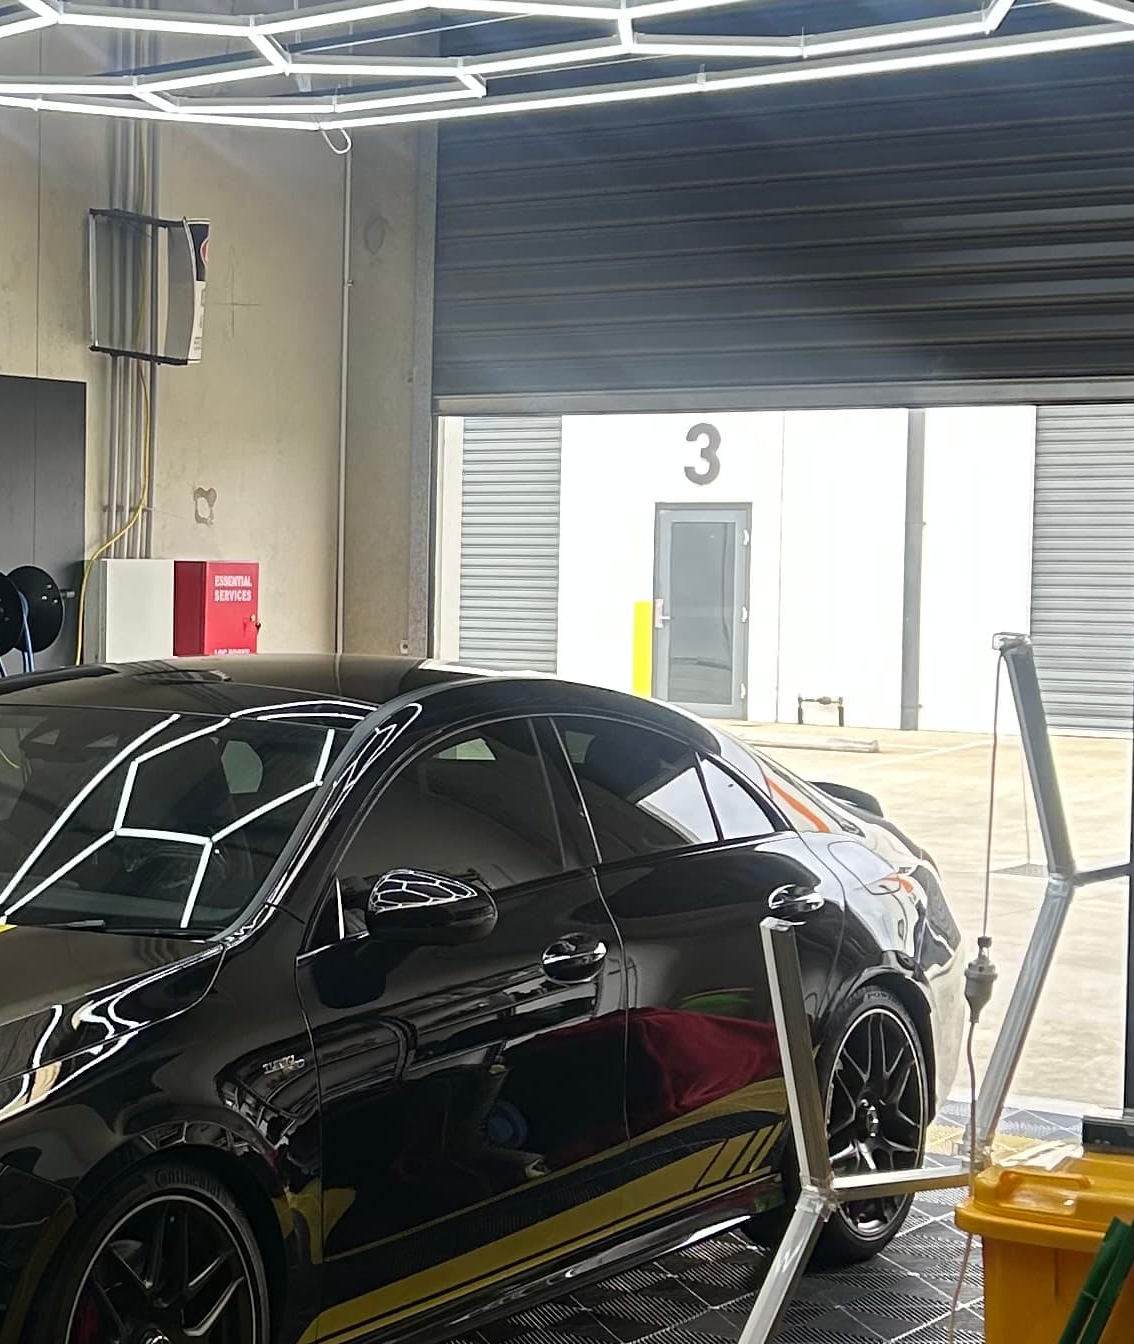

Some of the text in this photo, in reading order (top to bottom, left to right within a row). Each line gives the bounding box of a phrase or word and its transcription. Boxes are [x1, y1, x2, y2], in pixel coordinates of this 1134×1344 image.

[683, 422, 722, 485] 3
[214, 575, 253, 587] ESSENTIAL
[213, 589, 252, 602] SERVICES
